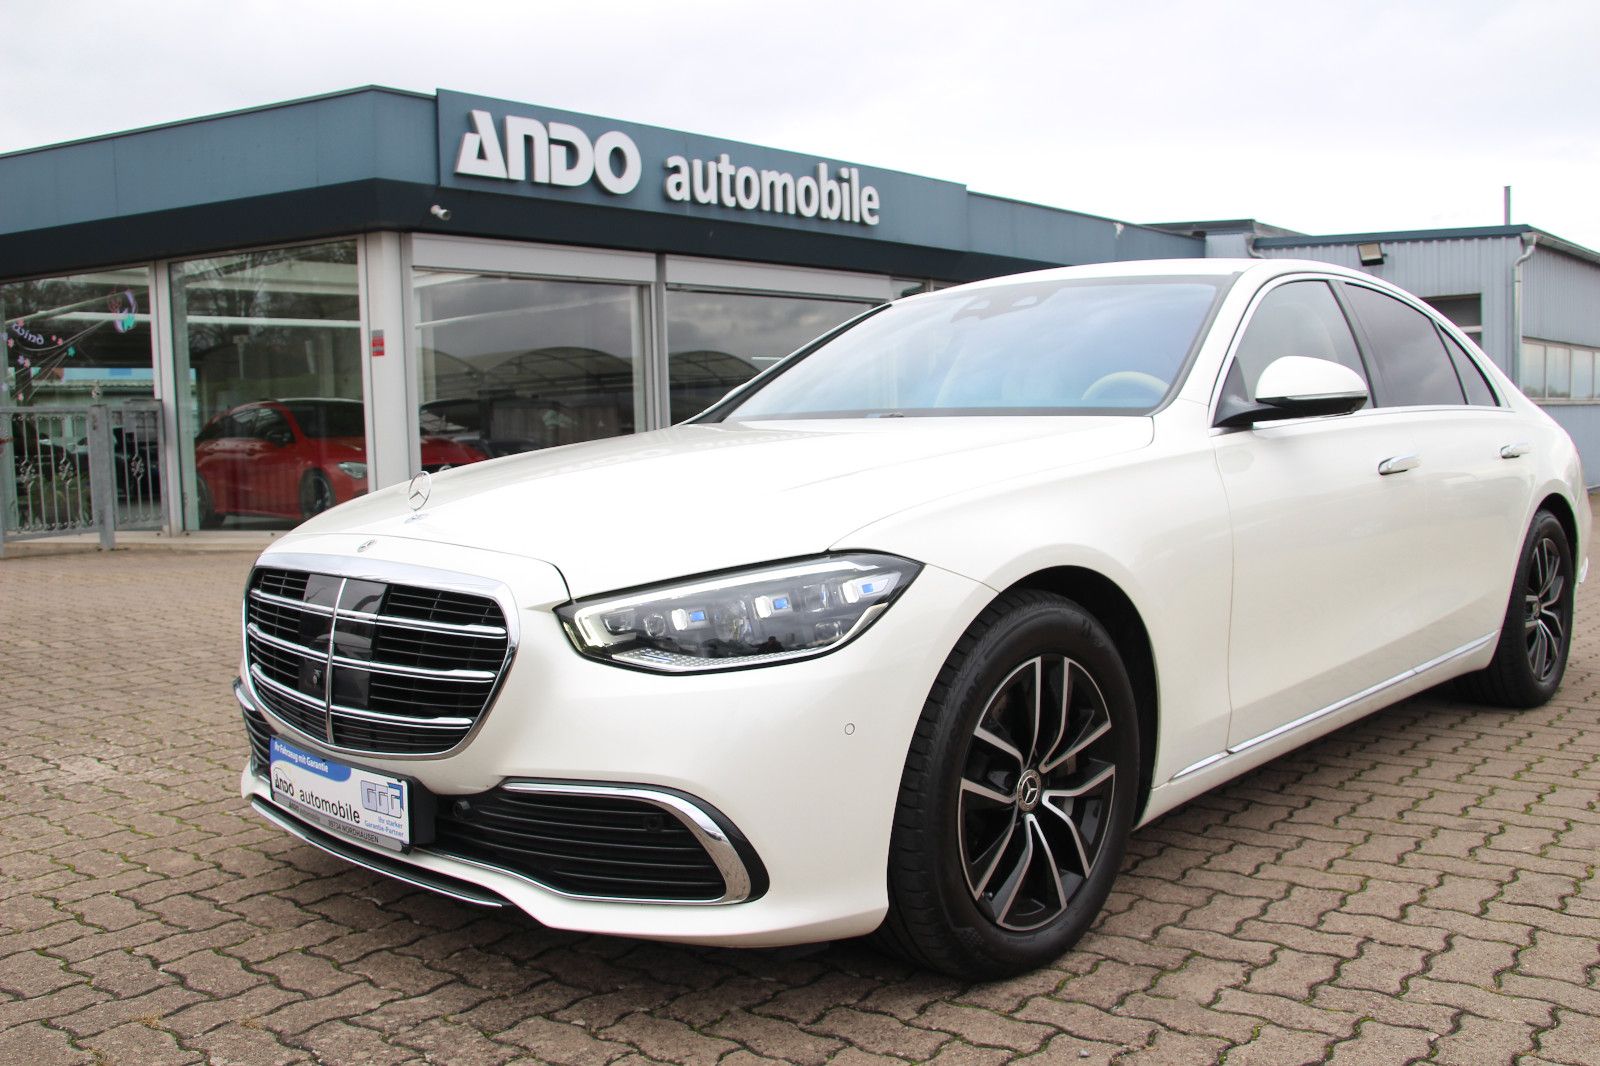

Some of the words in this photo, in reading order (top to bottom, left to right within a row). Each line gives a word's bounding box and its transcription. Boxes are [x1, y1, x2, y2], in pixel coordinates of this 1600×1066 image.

[454, 109, 642, 195] ANDO
[664, 153, 880, 226] automobile
[280, 744, 299, 763] Fahrzeug
[306, 757, 329, 773] Garantie
[299, 789, 361, 824] automobile
[341, 824, 379, 843] NORDHAUSEN
